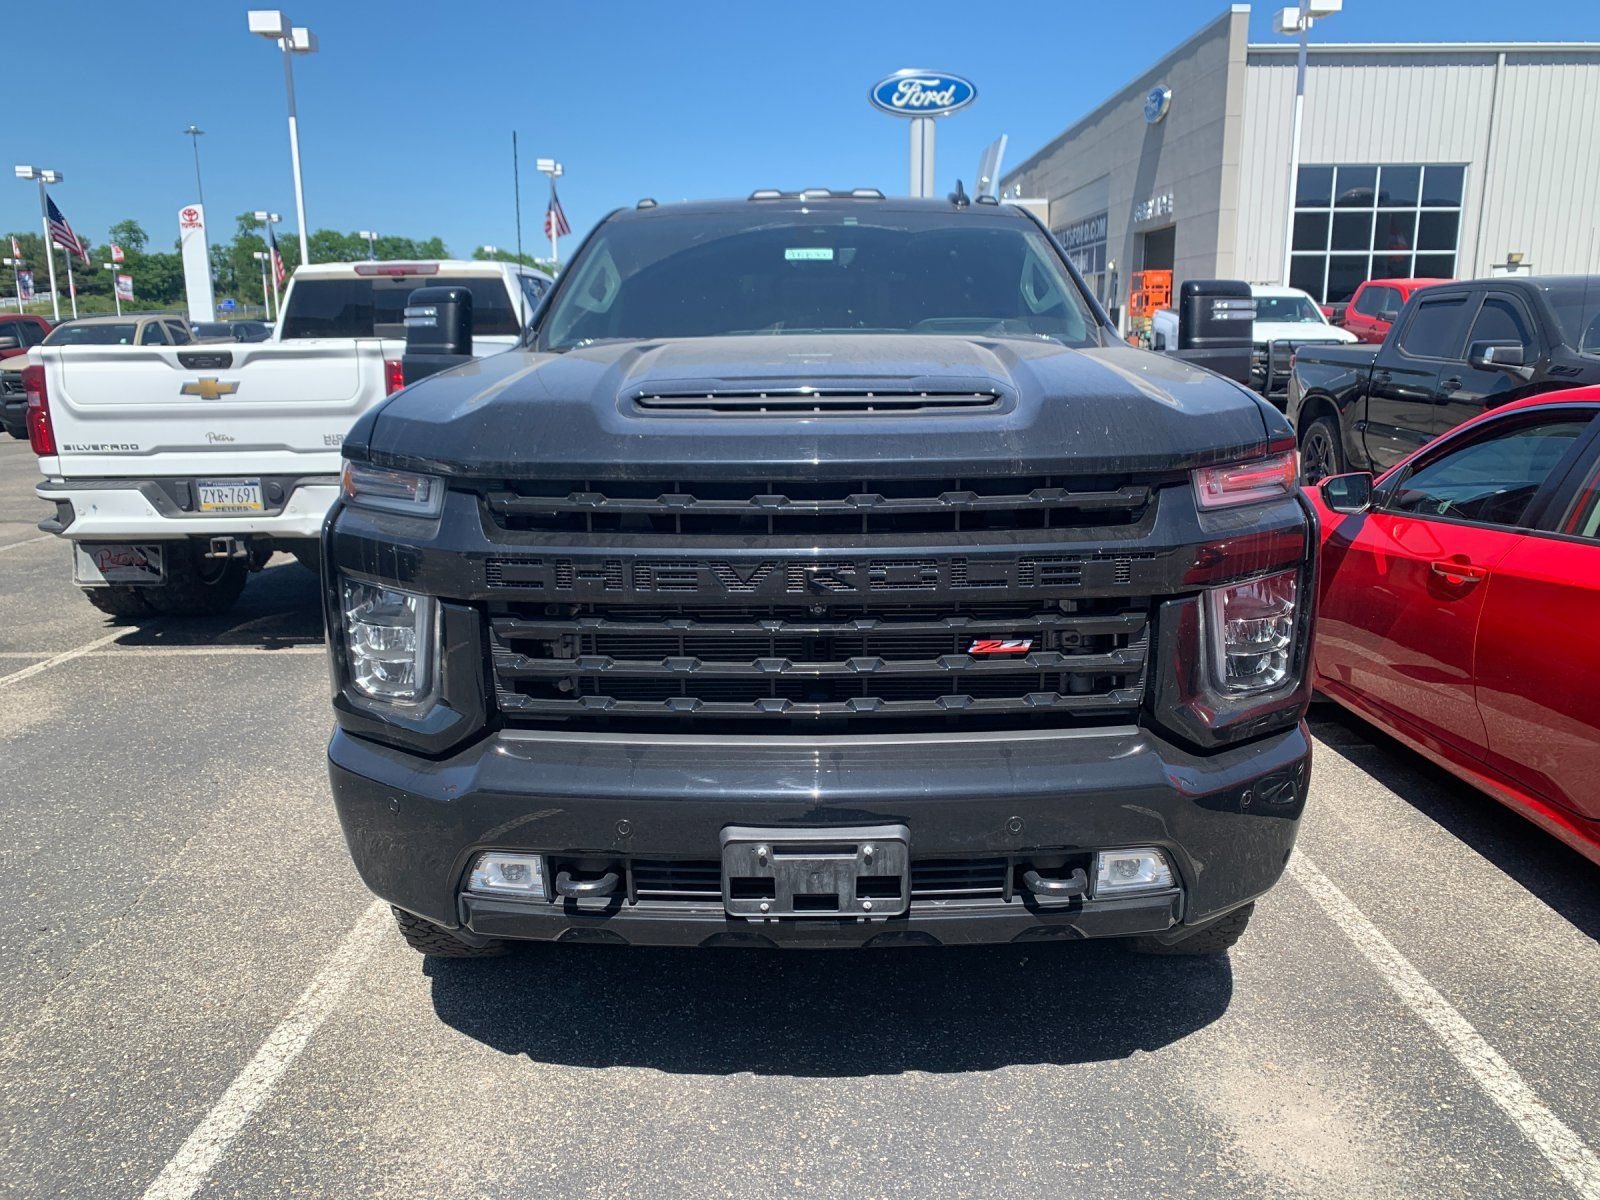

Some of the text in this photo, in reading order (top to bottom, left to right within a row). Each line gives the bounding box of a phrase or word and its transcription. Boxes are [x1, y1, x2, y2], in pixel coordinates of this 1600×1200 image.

[892, 79, 956, 106] Ford
[63, 443, 139, 451] SILVERADO
[485, 552, 1156, 593] CHEVROLET
[968, 639, 1033, 653] Z71
